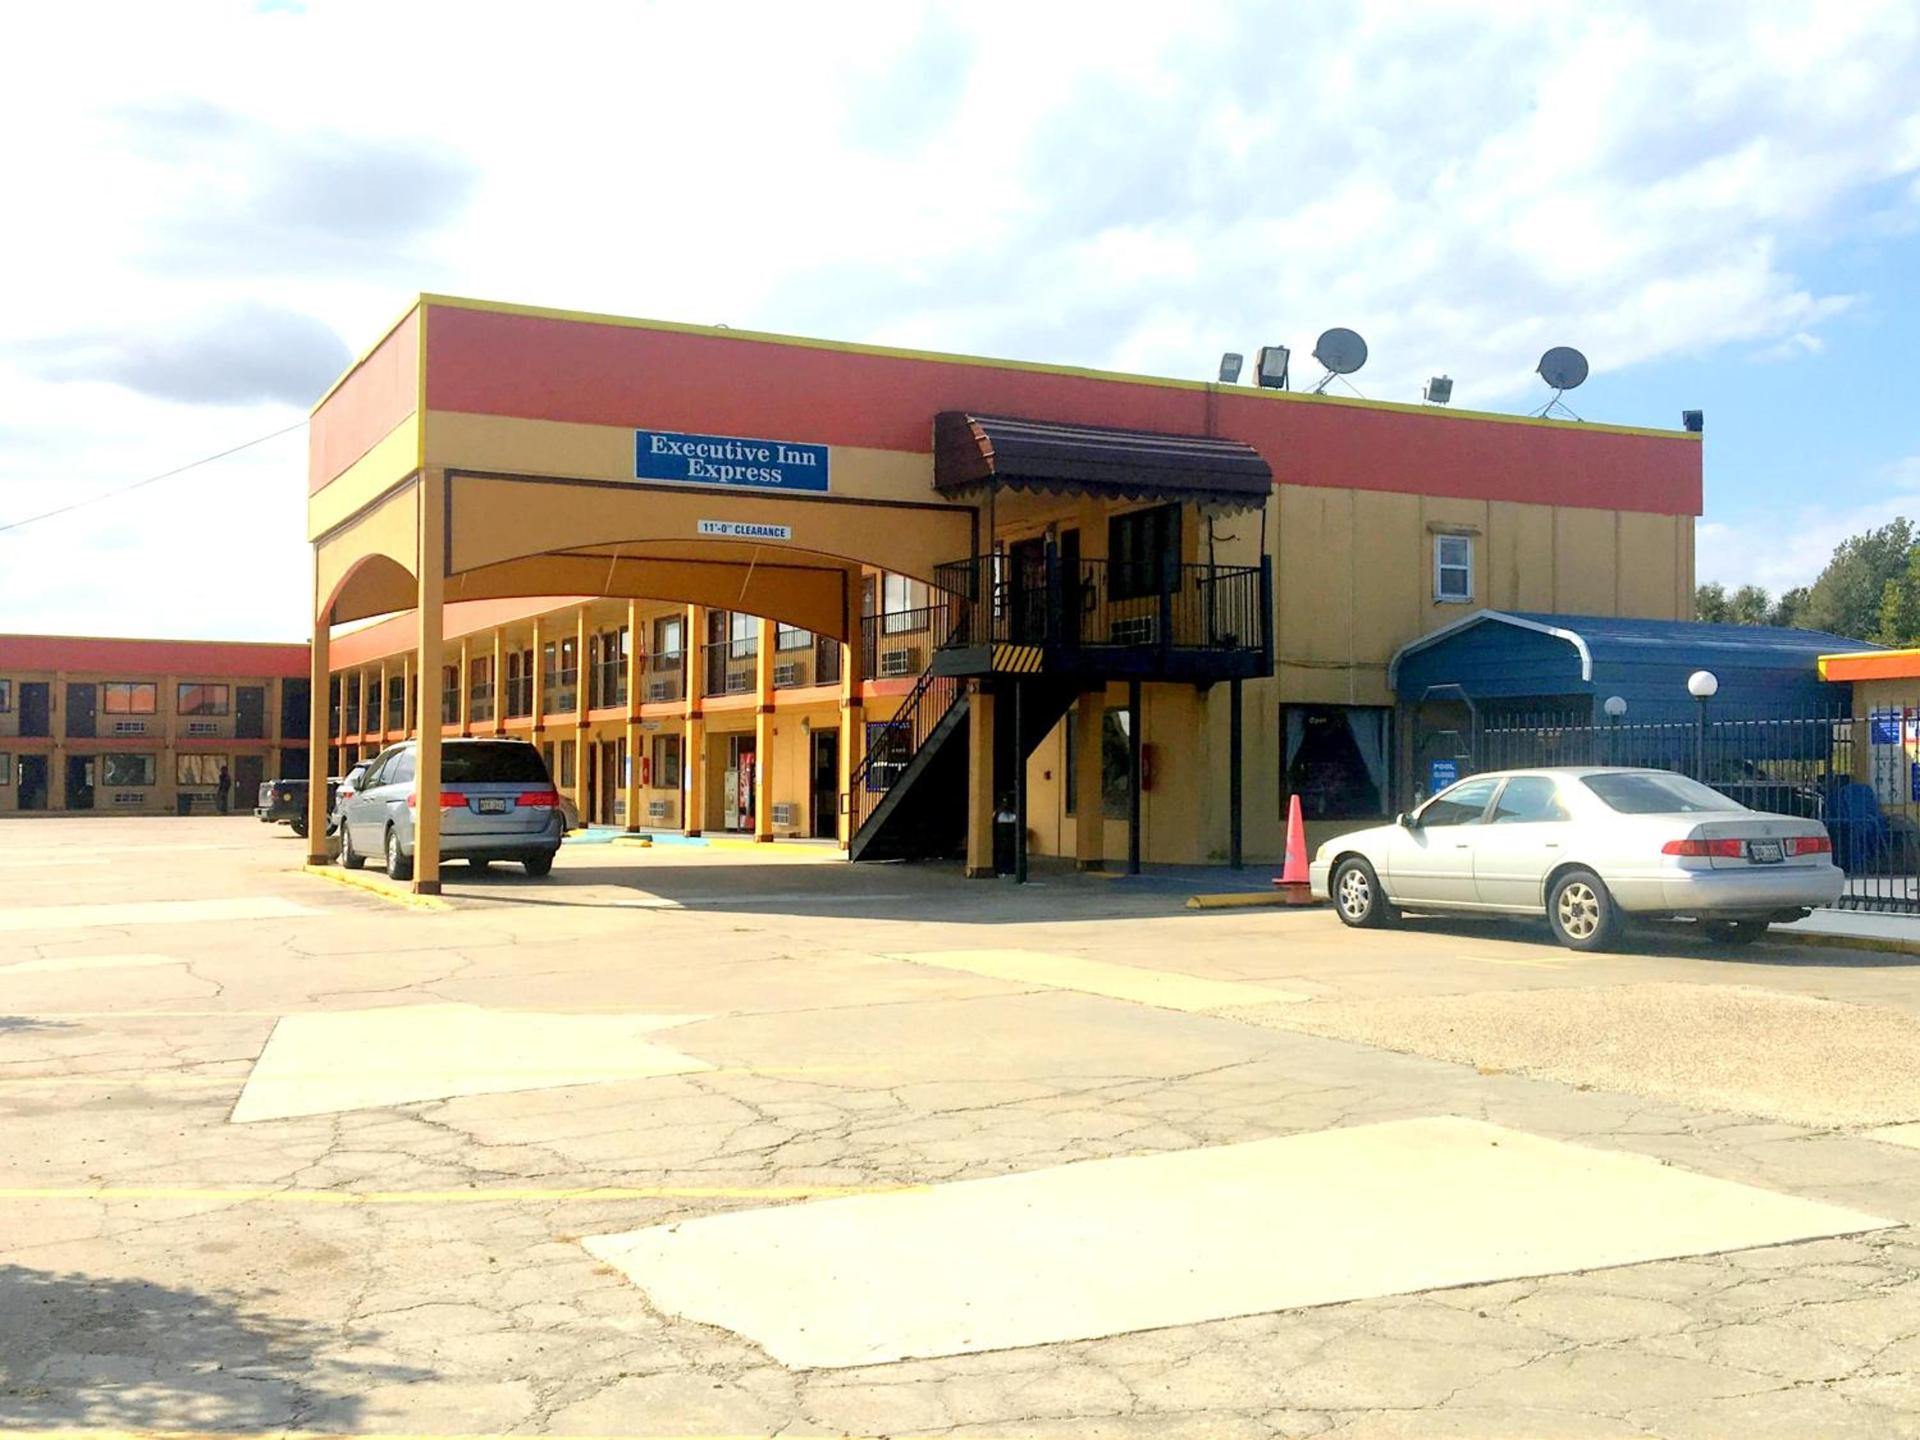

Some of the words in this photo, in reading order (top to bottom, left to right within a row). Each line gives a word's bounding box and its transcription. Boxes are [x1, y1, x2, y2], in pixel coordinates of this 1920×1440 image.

[650, 434, 770, 462] Executive
[776, 445, 816, 466] Inn
[687, 458, 782, 483] Express
[734, 525, 786, 538] CLEARANCE
